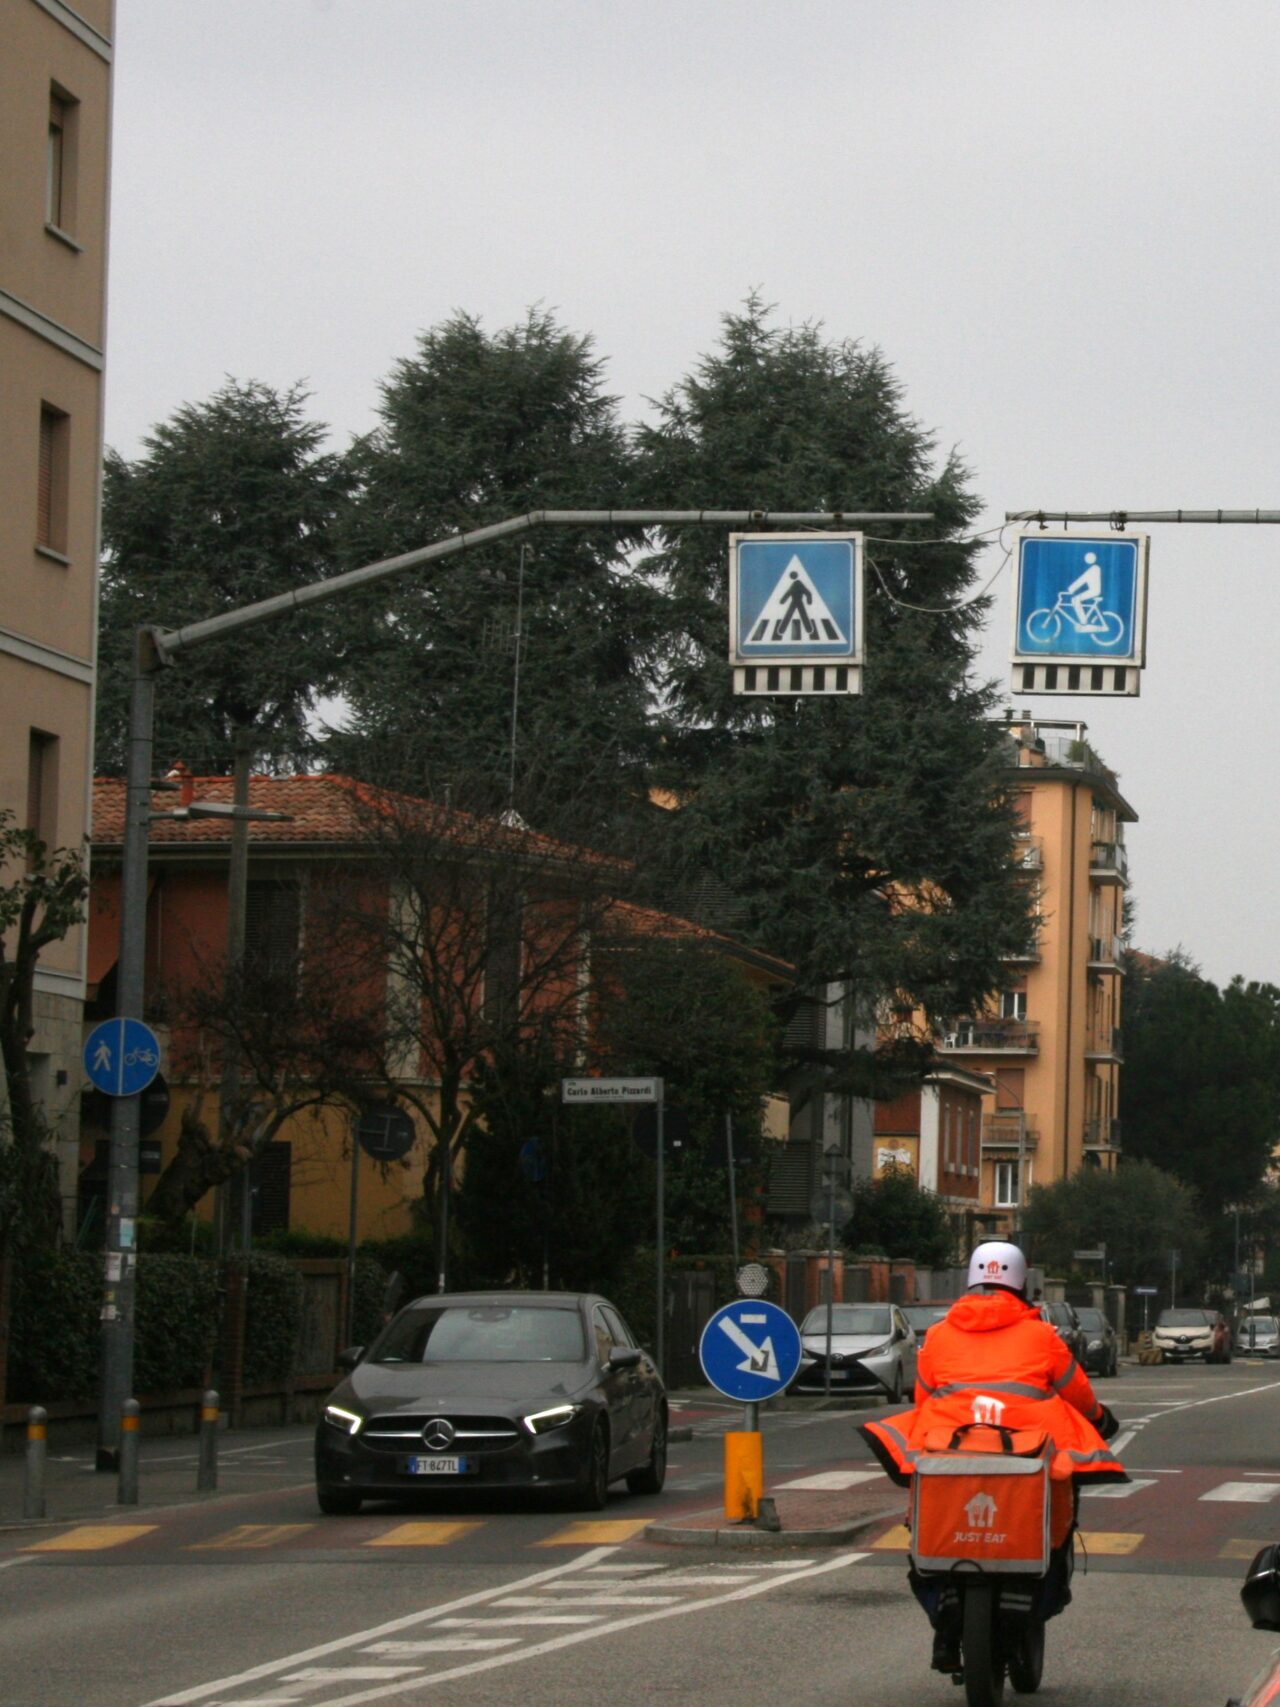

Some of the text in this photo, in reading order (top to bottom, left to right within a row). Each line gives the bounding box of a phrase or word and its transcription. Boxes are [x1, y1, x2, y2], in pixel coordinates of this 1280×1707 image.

[567, 1086, 651, 1096] Carlo Alberto Pizzardi
[953, 1532, 1007, 1543] JUST EAT
